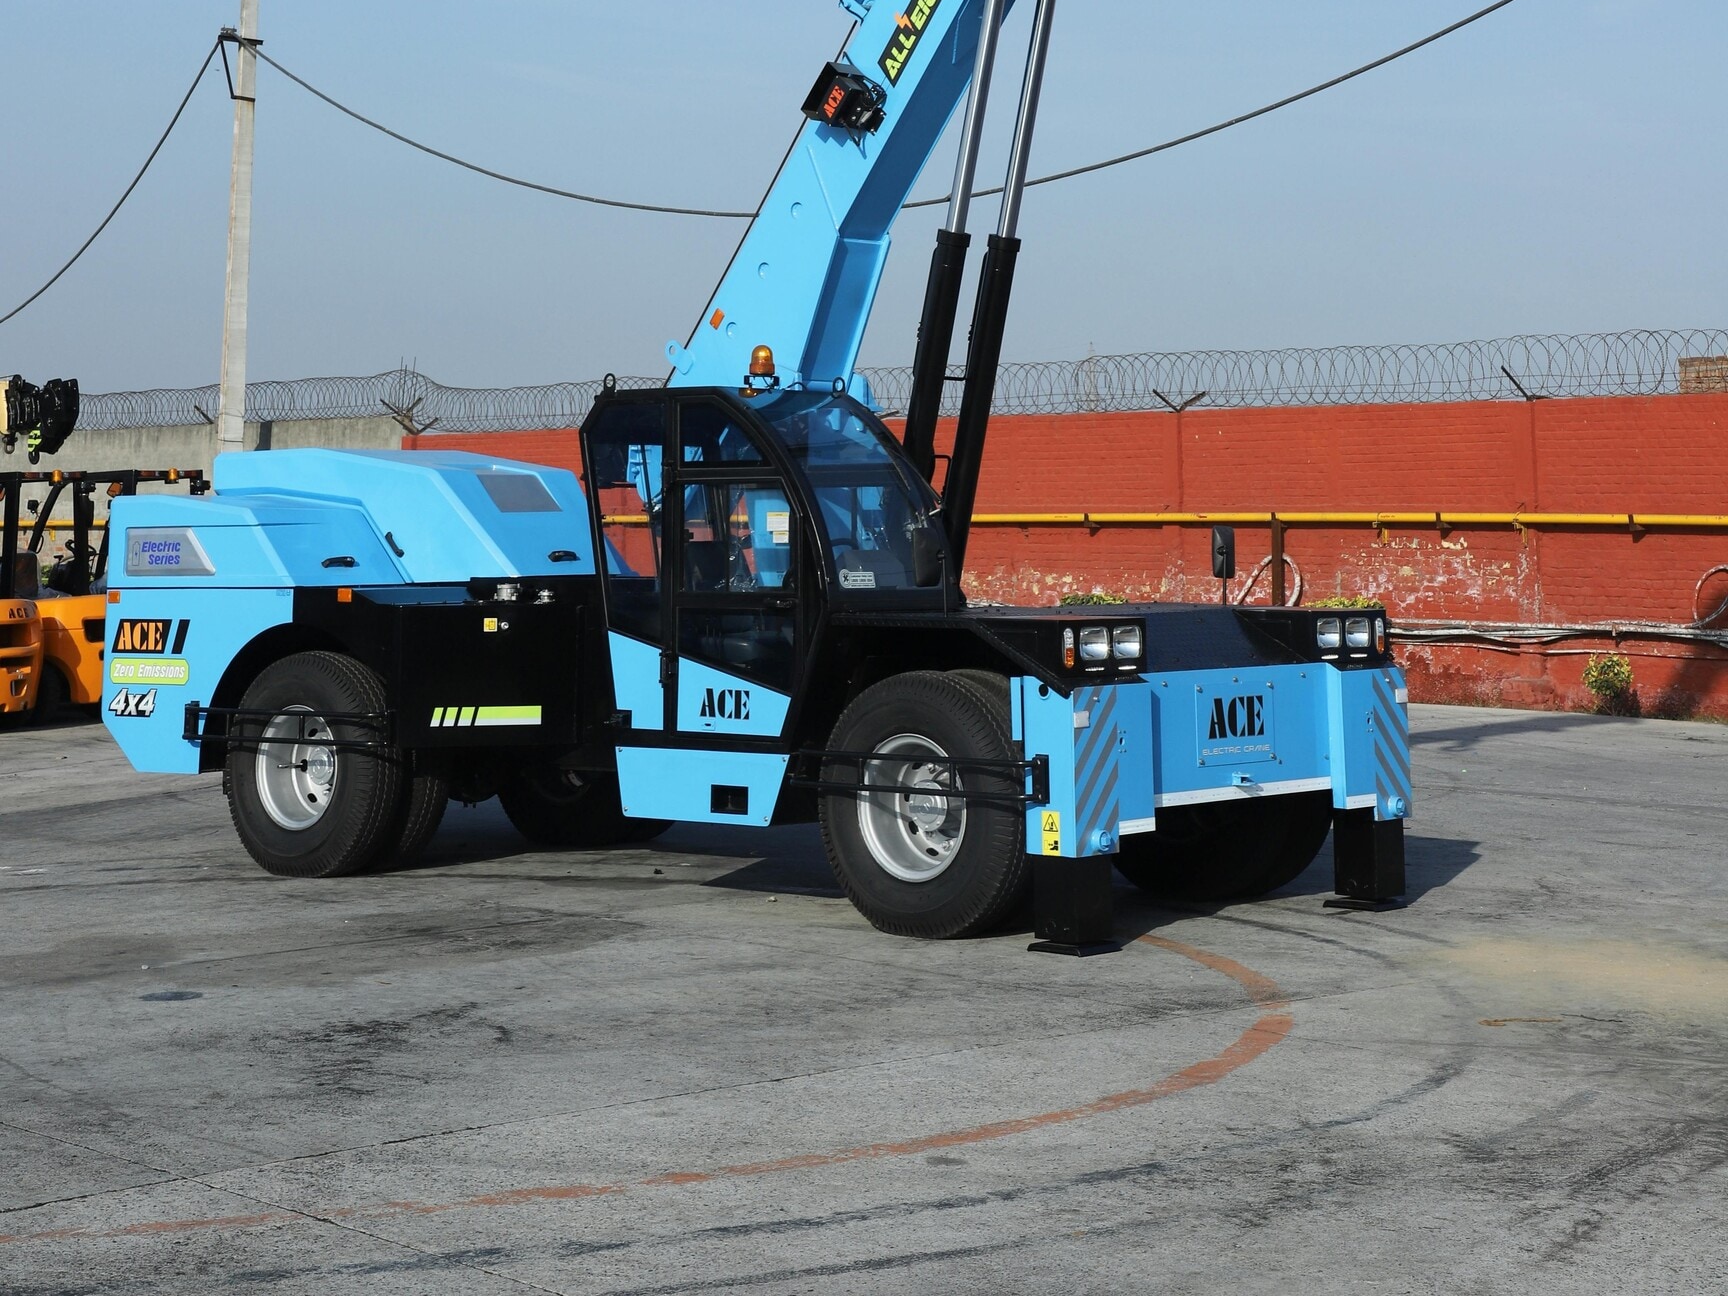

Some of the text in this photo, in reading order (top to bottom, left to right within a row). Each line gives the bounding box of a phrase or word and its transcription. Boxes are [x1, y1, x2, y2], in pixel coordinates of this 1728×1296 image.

[884, 33, 917, 80] ALL
[823, 85, 846, 119] ACE
[142, 541, 181, 553] Electric
[148, 554, 181, 565] Series
[117, 621, 164, 651] ACE
[114, 662, 185, 678] Zero Emissions
[109, 688, 157, 717] 4x4
[699, 688, 750, 720] ACE
[1208, 695, 1265, 740] ACE
[1202, 744, 1271, 756] ELECTRIC CRANE
